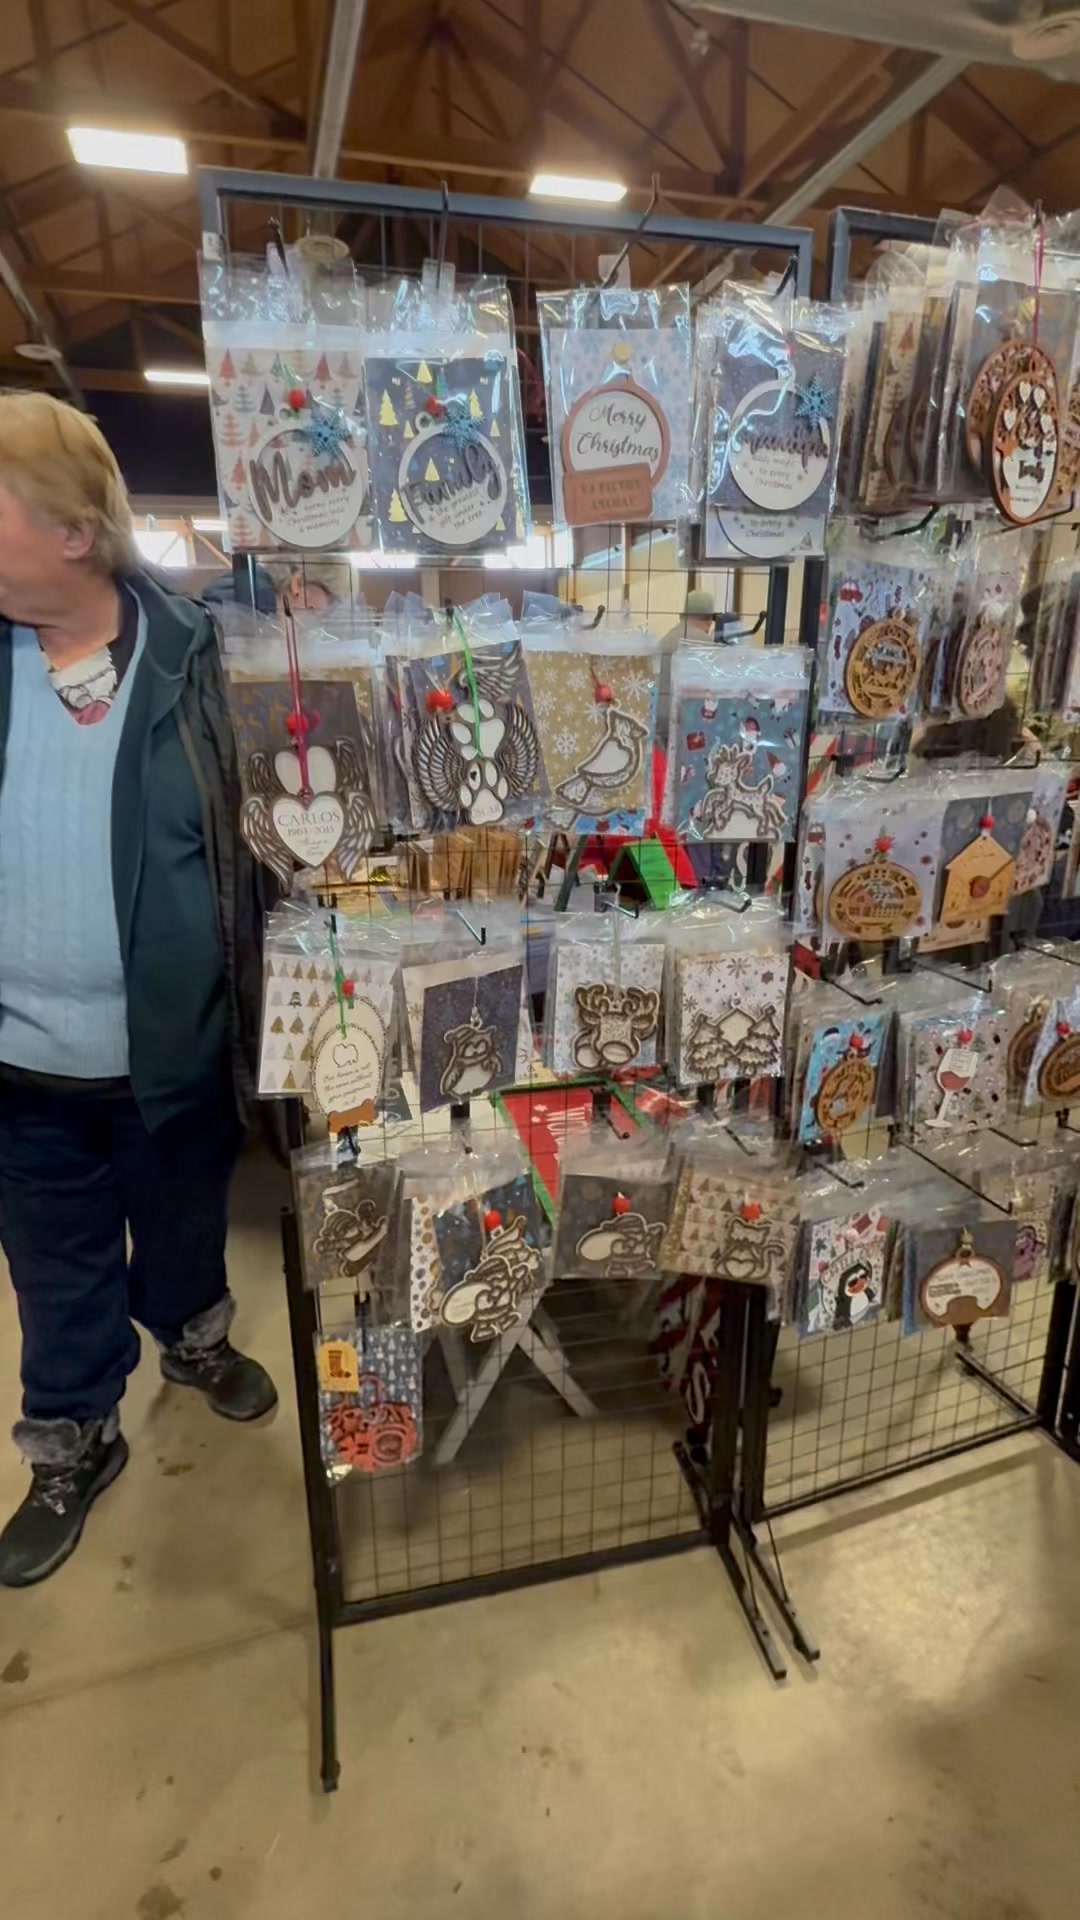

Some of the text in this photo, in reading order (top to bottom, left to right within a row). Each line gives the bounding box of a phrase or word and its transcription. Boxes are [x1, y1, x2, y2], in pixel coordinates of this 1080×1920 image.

[589, 403, 647, 433] Merry
[577, 432, 660, 462] Christmas
[249, 450, 357, 522] Mom
[400, 443, 502, 524] Family
[277, 811, 341, 827] CARLOS
